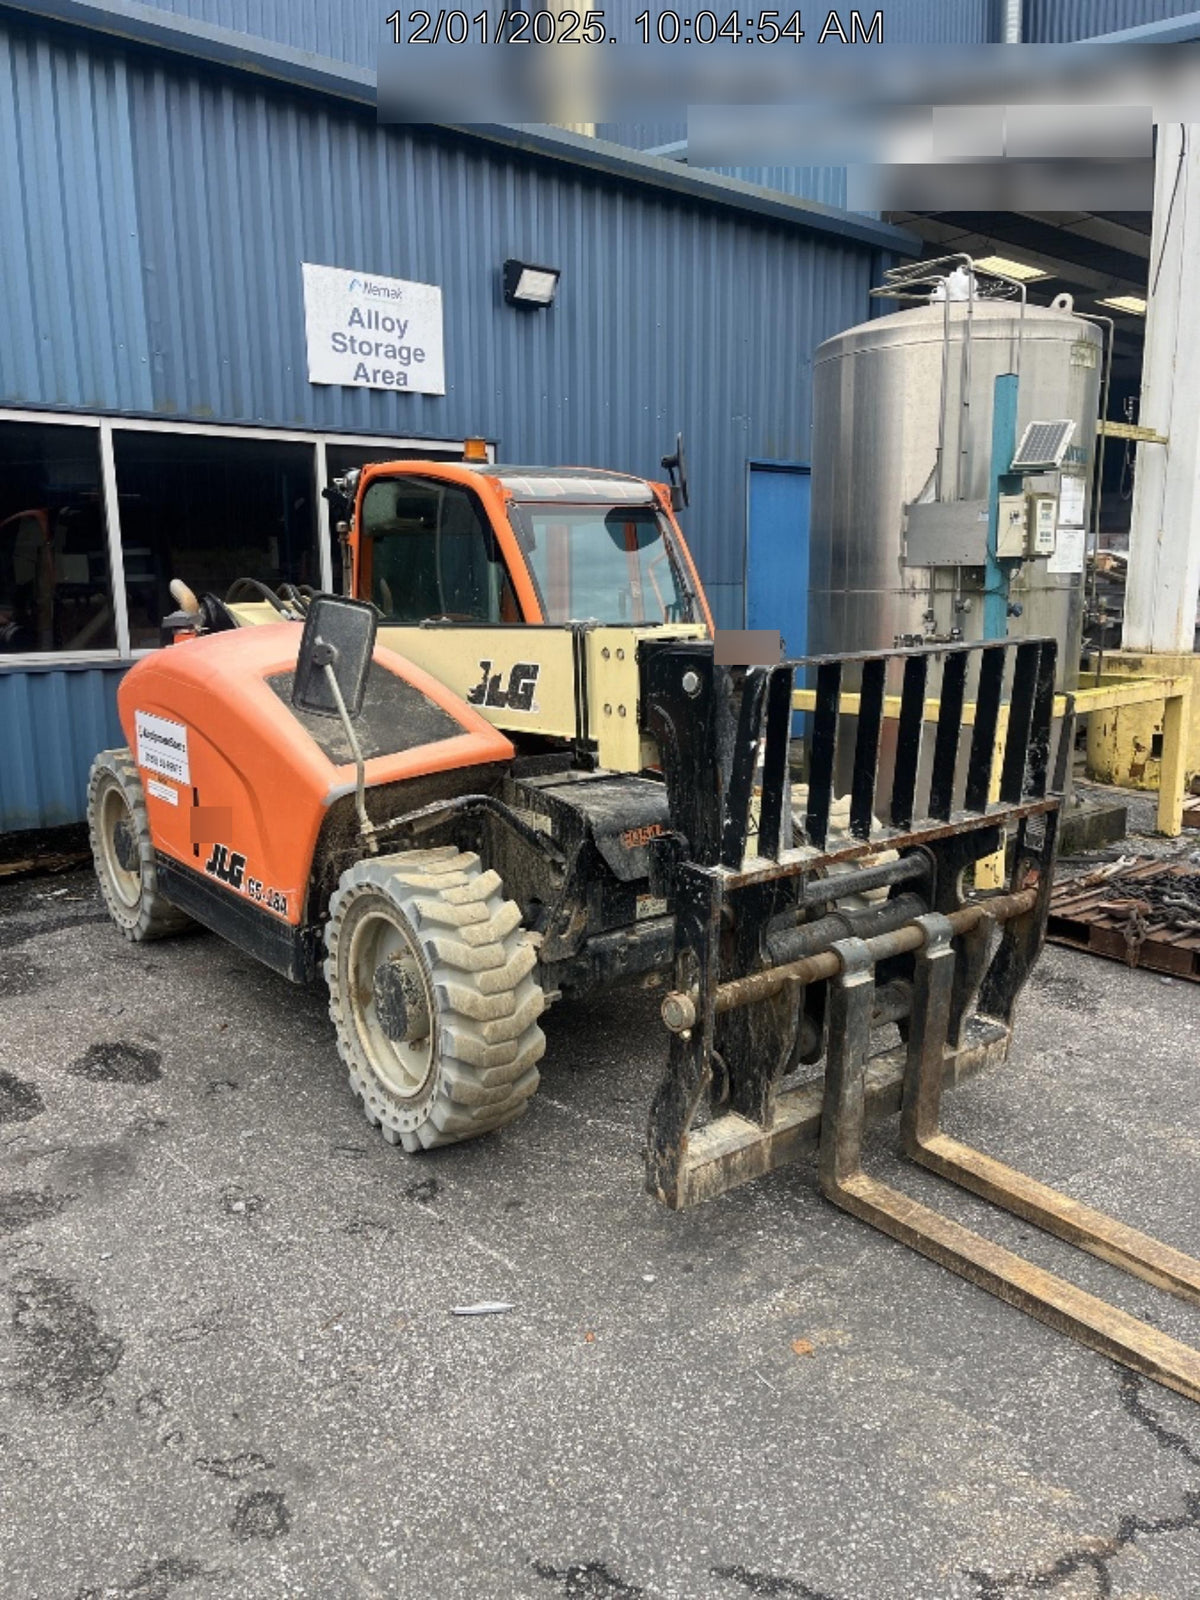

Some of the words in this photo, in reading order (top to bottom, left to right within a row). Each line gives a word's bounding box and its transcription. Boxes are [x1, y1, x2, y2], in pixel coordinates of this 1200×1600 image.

[362, 280, 403, 300] Nemak
[348, 307, 409, 339] Alloy
[331, 332, 426, 366] Storage
[353, 362, 409, 387] Area
[467, 660, 540, 713] JLG
[205, 843, 248, 890] JLG
